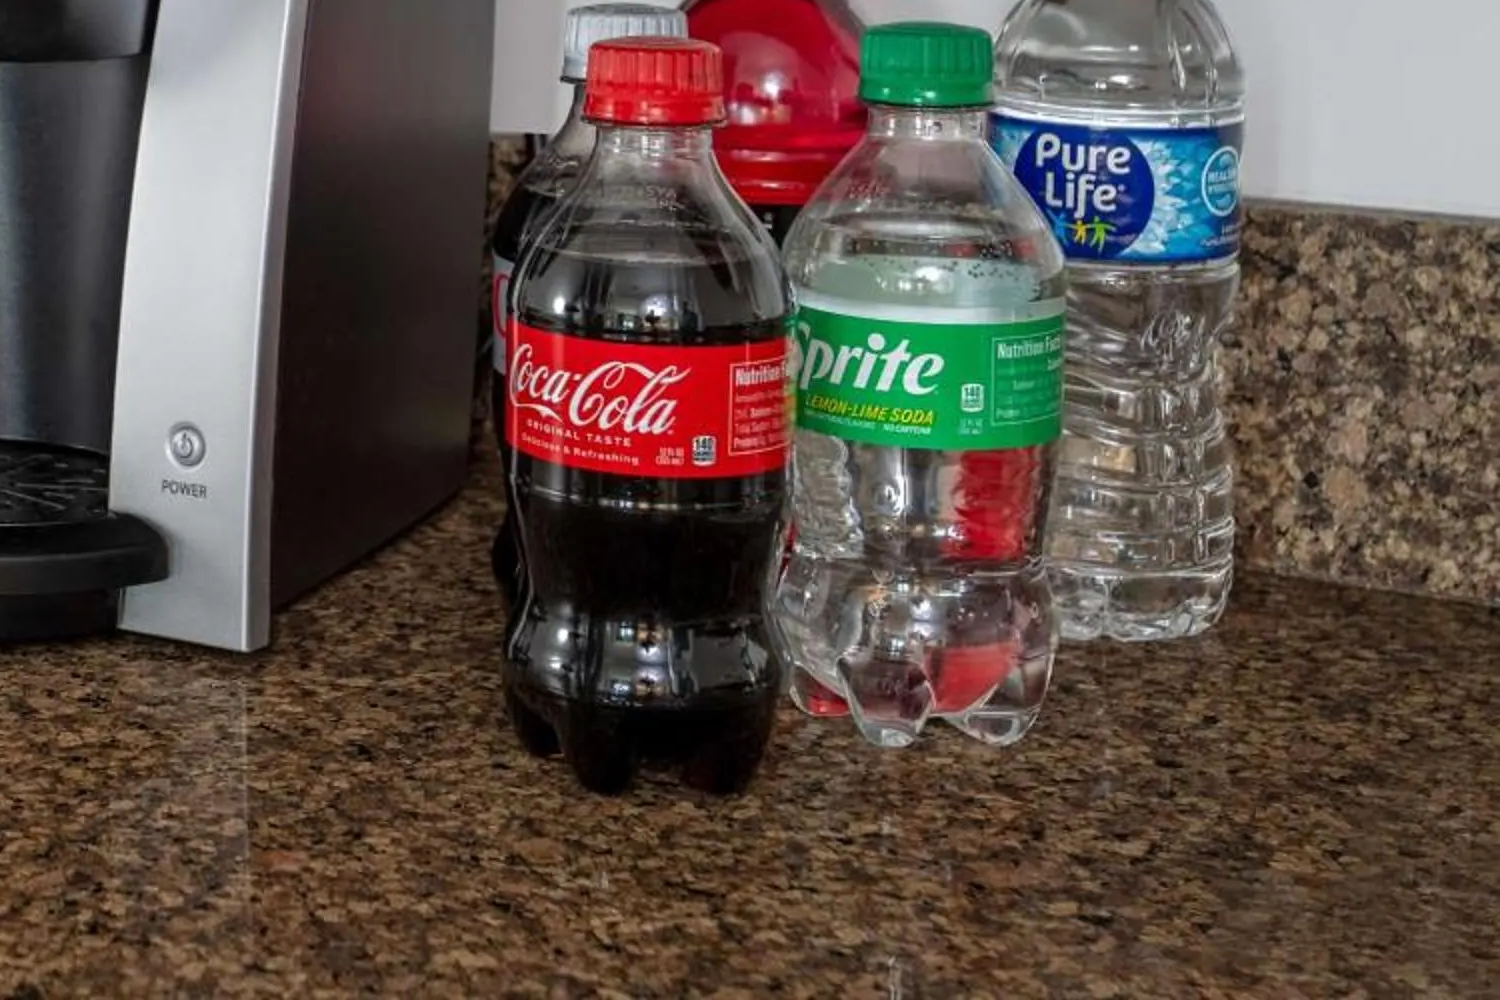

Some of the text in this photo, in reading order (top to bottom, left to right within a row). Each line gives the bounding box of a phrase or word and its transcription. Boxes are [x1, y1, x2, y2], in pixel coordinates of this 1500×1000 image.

[1035, 132, 1131, 175] Pure
[1045, 171, 1118, 219] Life
[509, 343, 692, 436] Coca-Cola
[527, 418, 633, 448] ORIGINAL TASTE
[889, 406, 934, 425] SODA
[161, 479, 207, 499] POWER
